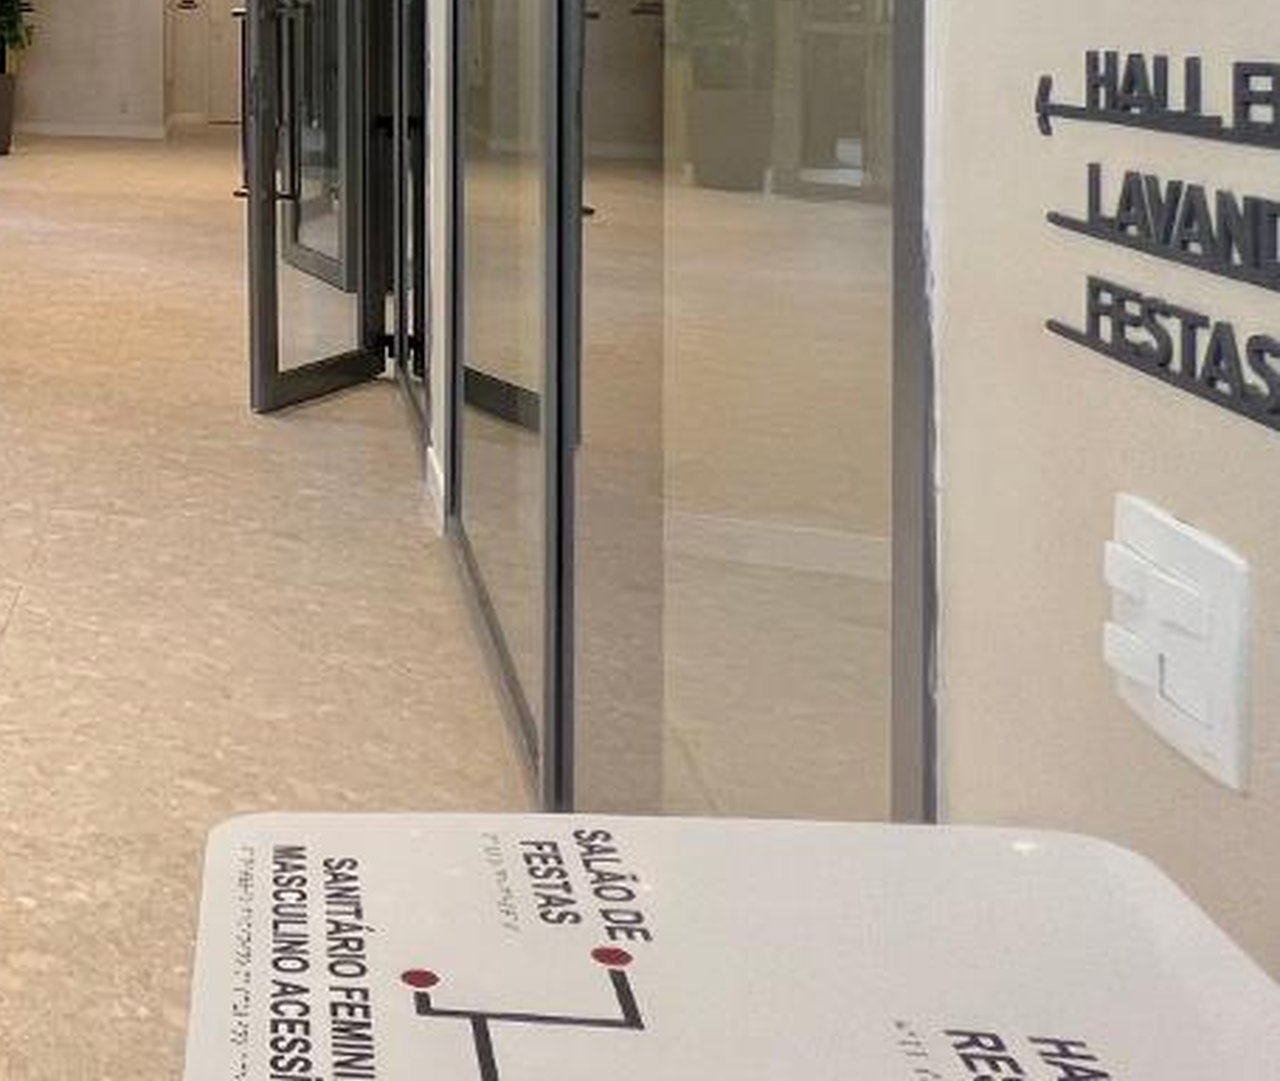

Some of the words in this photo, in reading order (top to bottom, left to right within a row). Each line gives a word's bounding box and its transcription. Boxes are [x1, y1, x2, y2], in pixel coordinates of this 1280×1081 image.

[1085, 51, 1221, 129] HALL
[1086, 275, 1280, 420] FESTAS
[519, 840, 582, 924] FESTAS
[572, 829, 639, 902] SALÃO
[272, 845, 310, 973] MASCULINO
[323, 858, 375, 978] SANITÁRIO
[599, 908, 653, 942] DE
